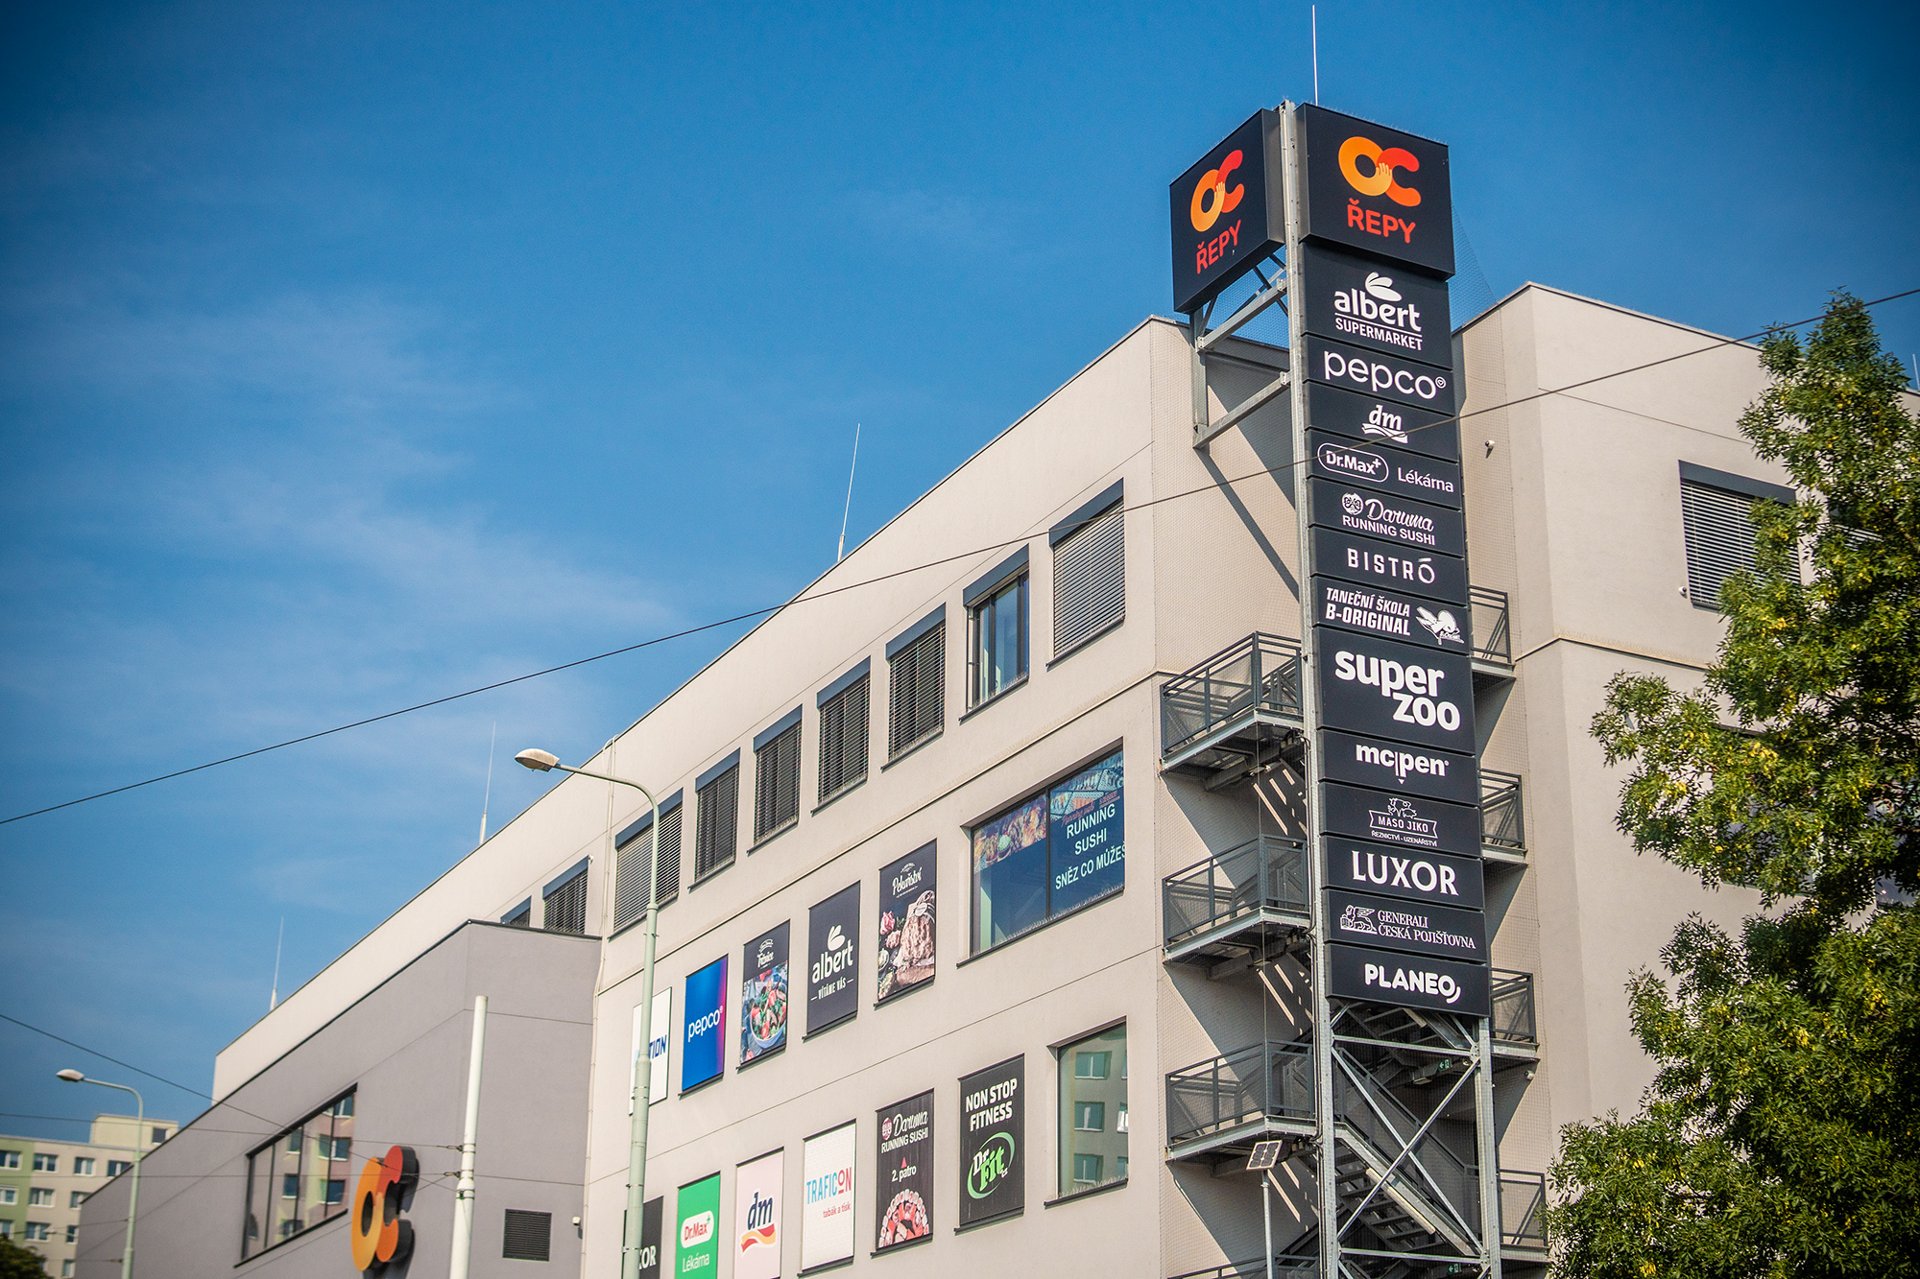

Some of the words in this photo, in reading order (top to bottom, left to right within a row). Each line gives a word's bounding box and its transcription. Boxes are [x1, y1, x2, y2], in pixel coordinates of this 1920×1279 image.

[1347, 198, 1416, 244] ŘEPY
[1196, 219, 1241, 275] ŘEPY
[1334, 290, 1421, 332] albert
[1335, 317, 1422, 351] SUPERMARKET
[1369, 405, 1402, 431] dm
[1397, 467, 1454, 493] Lékárna
[1342, 514, 1397, 537] RUNNING
[1400, 528, 1435, 546] SUSHI
[1365, 499, 1434, 532] Daruma
[1326, 587, 1375, 608] TANEČNÍ
[1376, 596, 1411, 617] ŠKOLA
[1325, 603, 1411, 636] B-ORIGINAL
[1335, 651, 1445, 697] super
[1392, 692, 1461, 731] zoo
[1066, 803, 1115, 839] RUNNING
[1378, 815, 1404, 829] MASO
[1407, 820, 1429, 833] JIKO
[1074, 828, 1107, 855] SUSHI
[1055, 865, 1079, 890] SNĚZ
[1080, 859, 1094, 877] CO
[1352, 850, 1459, 896] LUXOR
[1377, 910, 1429, 929] GENERALI
[1378, 923, 1412, 940] ČESKÁ
[812, 939, 853, 984] albert
[1364, 963, 1461, 1004] PLANEO
[965, 1087, 988, 1113] NON
[989, 1077, 1018, 1104] STOP
[969, 1100, 1014, 1132] FITNESS
[881, 1134, 909, 1154] RUNNING
[909, 1127, 928, 1143] SUSHI
[806, 1167, 852, 1204] TRAFICON
[899, 1165, 917, 1182] patro
[747, 1191, 773, 1230] dm
